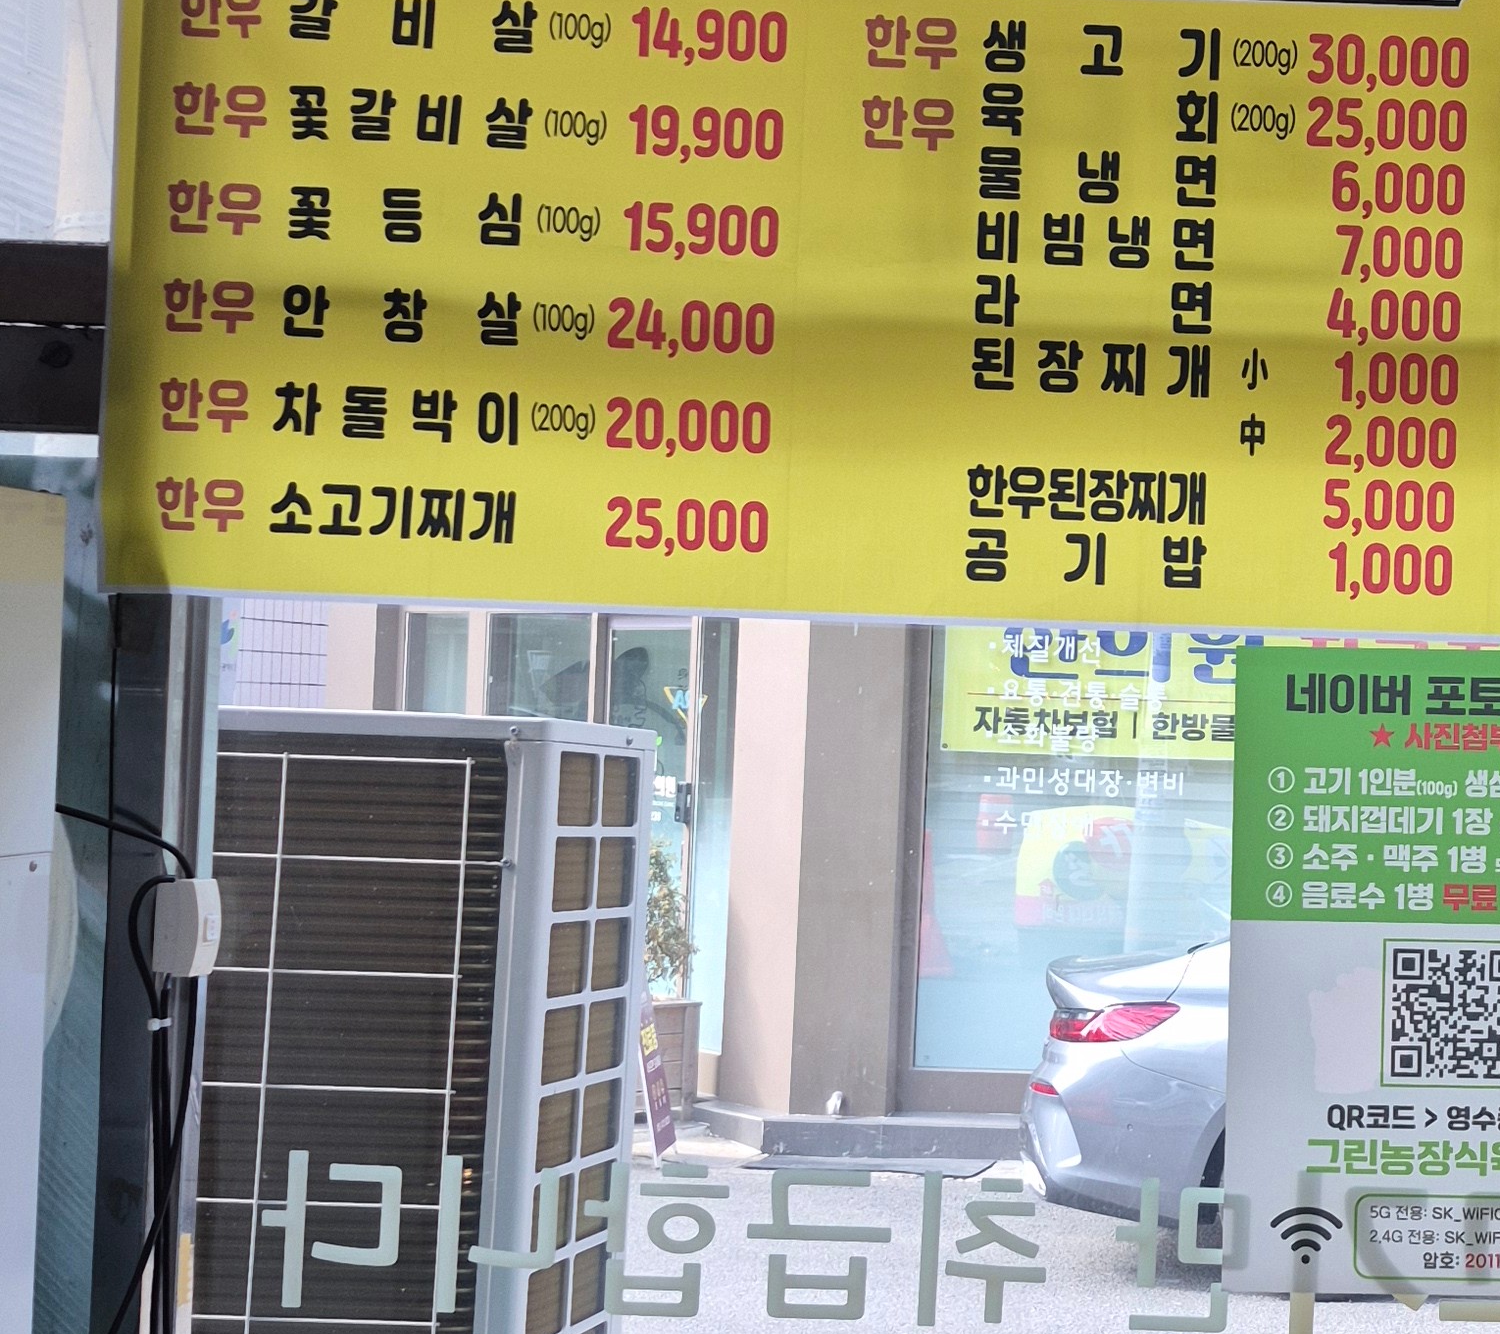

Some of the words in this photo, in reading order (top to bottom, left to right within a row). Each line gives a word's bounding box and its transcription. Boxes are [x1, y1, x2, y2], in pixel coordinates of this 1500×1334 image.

[549, 12, 611, 48] (100g)
[632, 7, 788, 65] 14,900
[865, 15, 957, 69] 한우
[1233, 38, 1298, 75] (200g)
[1308, 33, 1469, 93] 30,000
[173, 82, 268, 138] 한우
[544, 109, 607, 145] (100g)
[629, 105, 784, 163] 19,900
[862, 96, 954, 151] 한우
[1231, 104, 1295, 138] (200g)
[1306, 97, 1467, 156] 25,000
[1332, 161, 1465, 219] 6,000
[168, 180, 262, 236] 한우
[537, 207, 601, 243] (100g)
[624, 201, 779, 260] 15,900
[1336, 225, 1463, 283] 7,000
[163, 279, 254, 334] 한우
[533, 303, 594, 338] (100g)
[607, 297, 775, 358] 24,000
[1328, 288, 1461, 346] 4,000
[1241, 348, 1268, 391] 小
[1335, 352, 1459, 410] 1,000
[159, 378, 249, 433] 한우
[531, 403, 596, 438] (200g)
[606, 397, 771, 457] 20,000
[1241, 412, 1266, 456] 中
[1326, 416, 1457, 473] 2,000
[156, 477, 244, 533] 한우
[269, 481, 516, 545] 소고기찌개
[605, 496, 769, 556] 25,000
[967, 464, 1206, 526] 한우된장찌개
[1324, 480, 1454, 537] 5,000
[1329, 543, 1452, 601] 1,000
[1286, 672, 1411, 716] 네이버
[1304, 768, 1350, 796] 고기
[1303, 806, 1443, 836] 돼지껍데기
[1452, 808, 1492, 835] 1장
[1302, 843, 1358, 872] 소주
[1384, 845, 1438, 873] 맥주
[1447, 846, 1487, 874] 1병
[1302, 881, 1386, 911] 음료수
[1395, 884, 1433, 911] 1병
[1442, 883, 1498, 912] 무료
[1327, 1104, 1416, 1131] QR코드
[1370, 1205, 1390, 1219] 5G
[1395, 1205, 1427, 1221] 전용:
[1408, 1229, 1440, 1245] 전용:
[1423, 1252, 1460, 1270] 암호:
